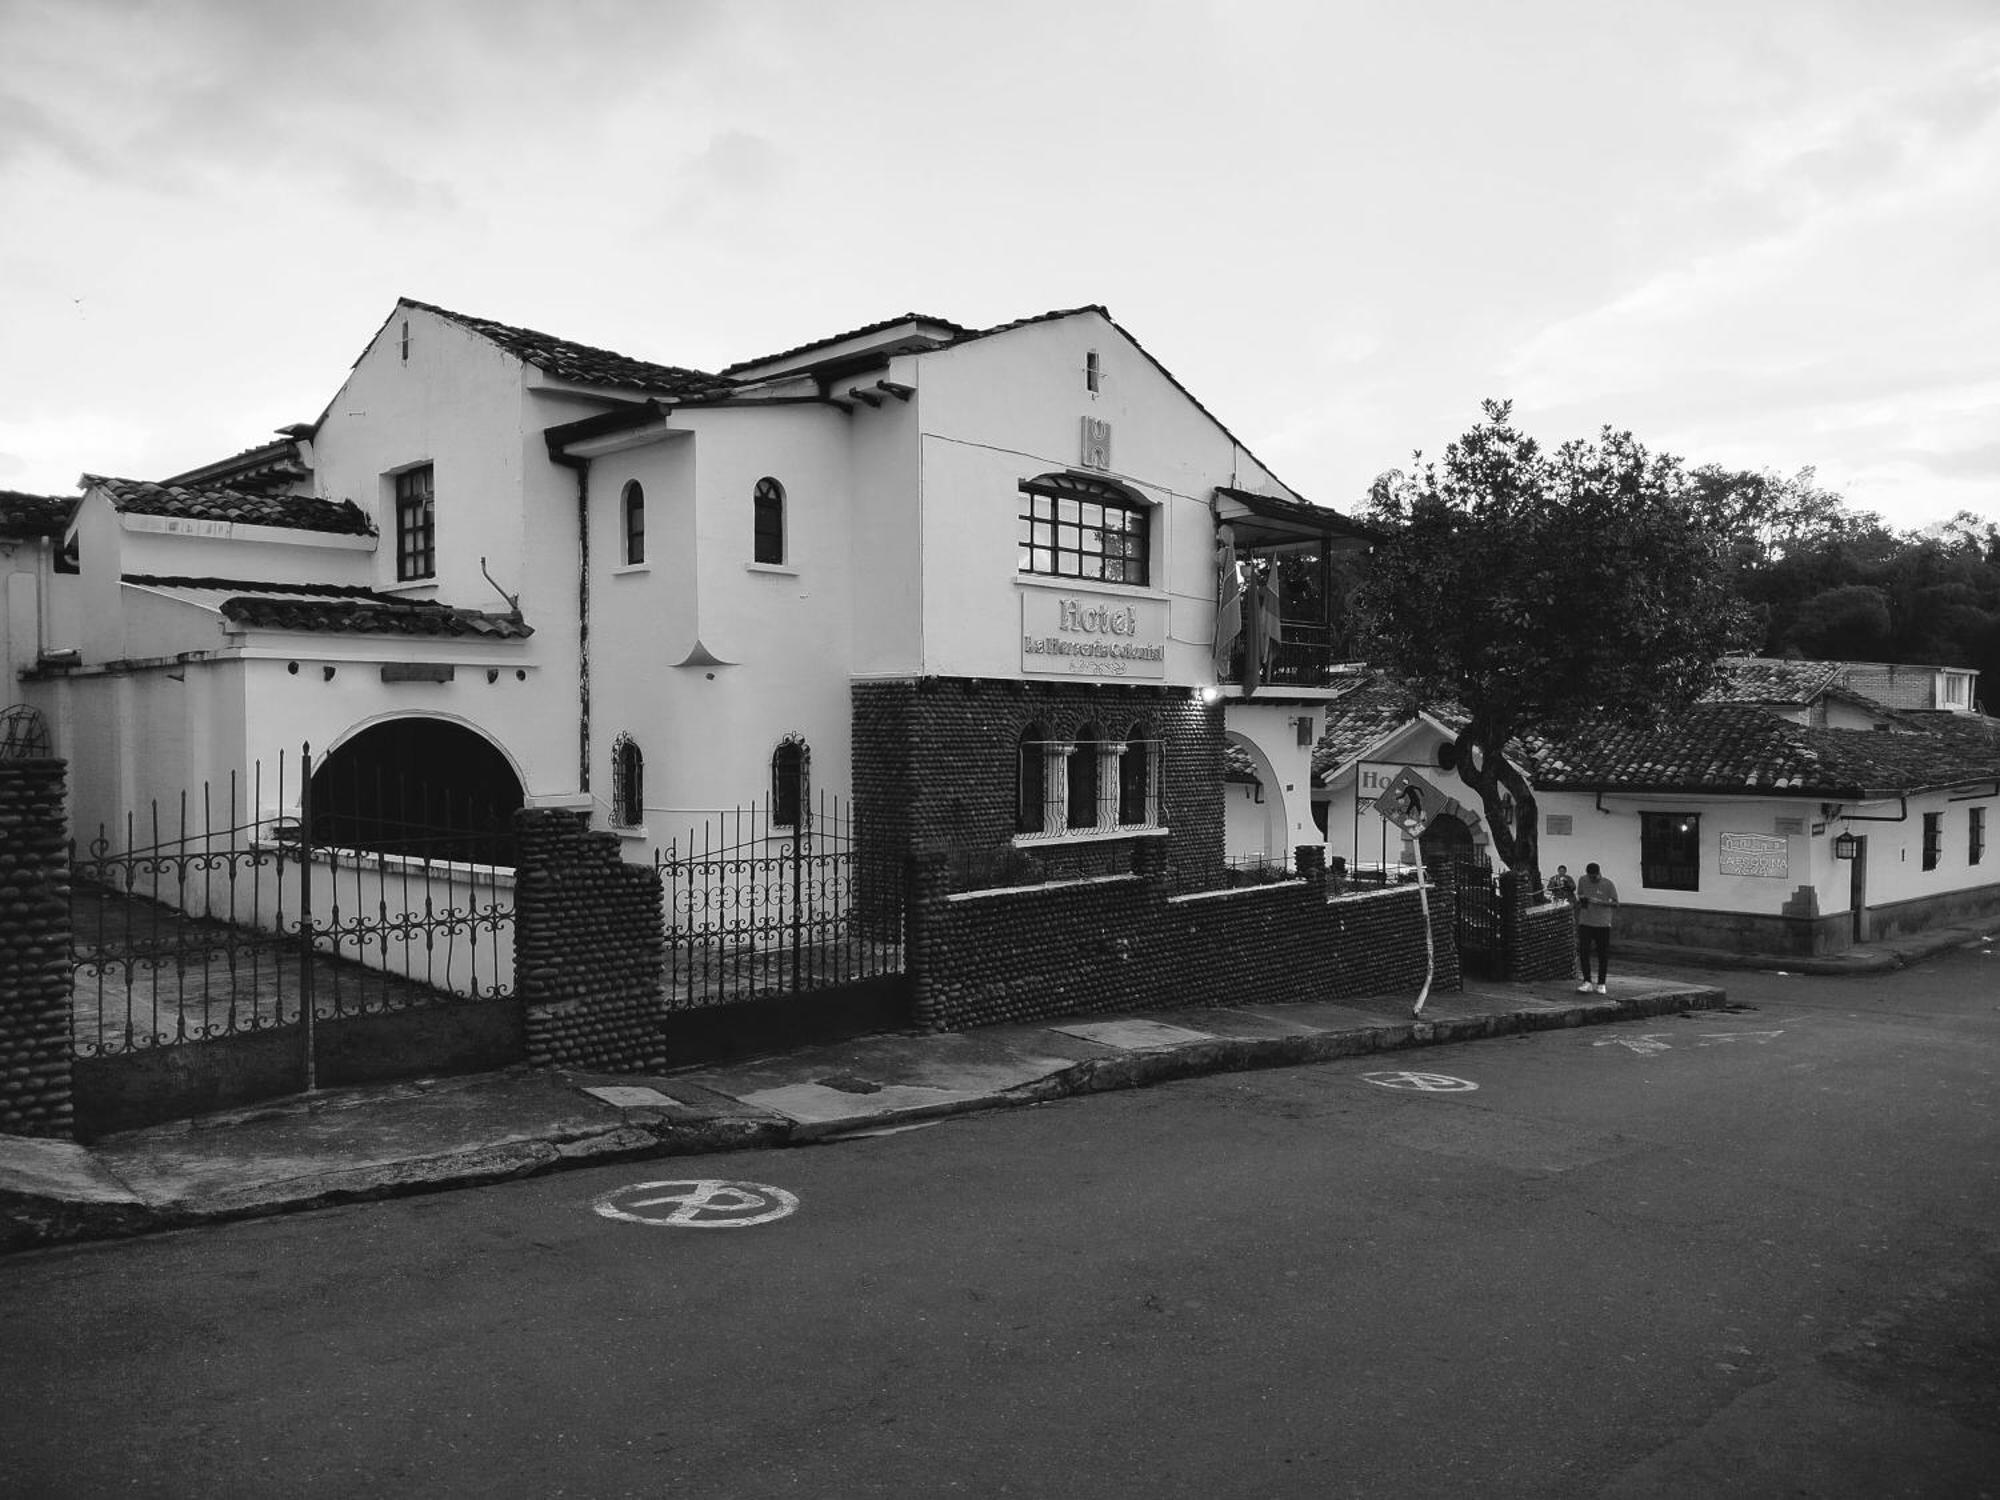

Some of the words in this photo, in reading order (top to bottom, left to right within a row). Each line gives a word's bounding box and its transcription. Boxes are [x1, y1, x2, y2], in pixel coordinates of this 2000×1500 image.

[1059, 599, 1136, 637] Hotel
[1024, 636, 1044, 654] La
[1363, 771, 1394, 790] Ho
